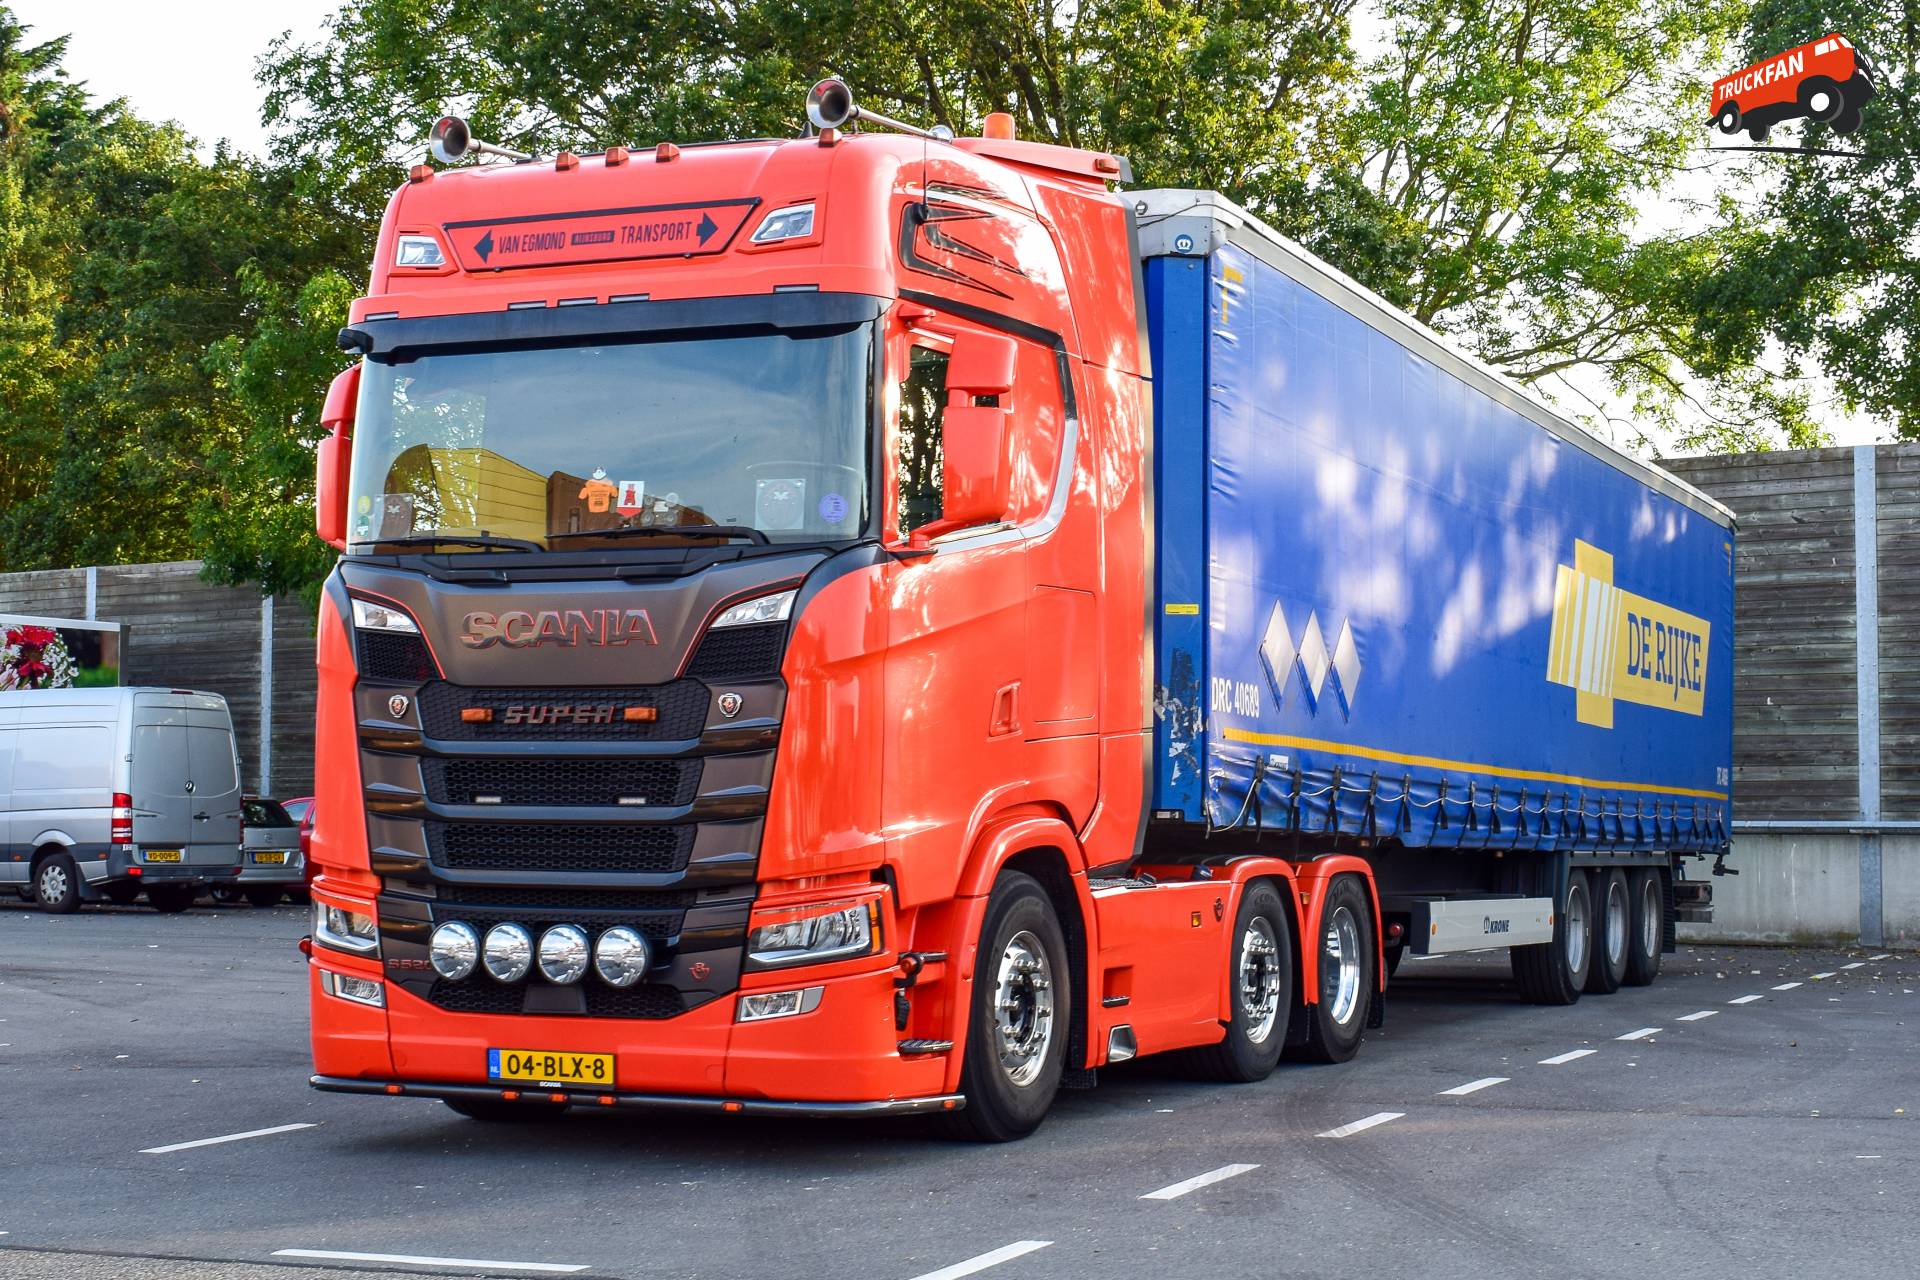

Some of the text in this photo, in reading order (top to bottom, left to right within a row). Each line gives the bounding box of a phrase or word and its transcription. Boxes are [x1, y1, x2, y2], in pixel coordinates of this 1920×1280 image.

[498, 236, 519, 254] VAN
[521, 231, 566, 252] EGMOND
[620, 221, 693, 244] TRANSPORT
[460, 608, 659, 649] SCANIA
[1626, 611, 1701, 703] DE RIJKE
[1211, 676, 1260, 719] DRC 40689
[504, 706, 616, 724] SUPER
[1489, 919, 1510, 934] KRONE
[490, 1065, 500, 1074] NL
[507, 1054, 605, 1079] 04-BLX-8
